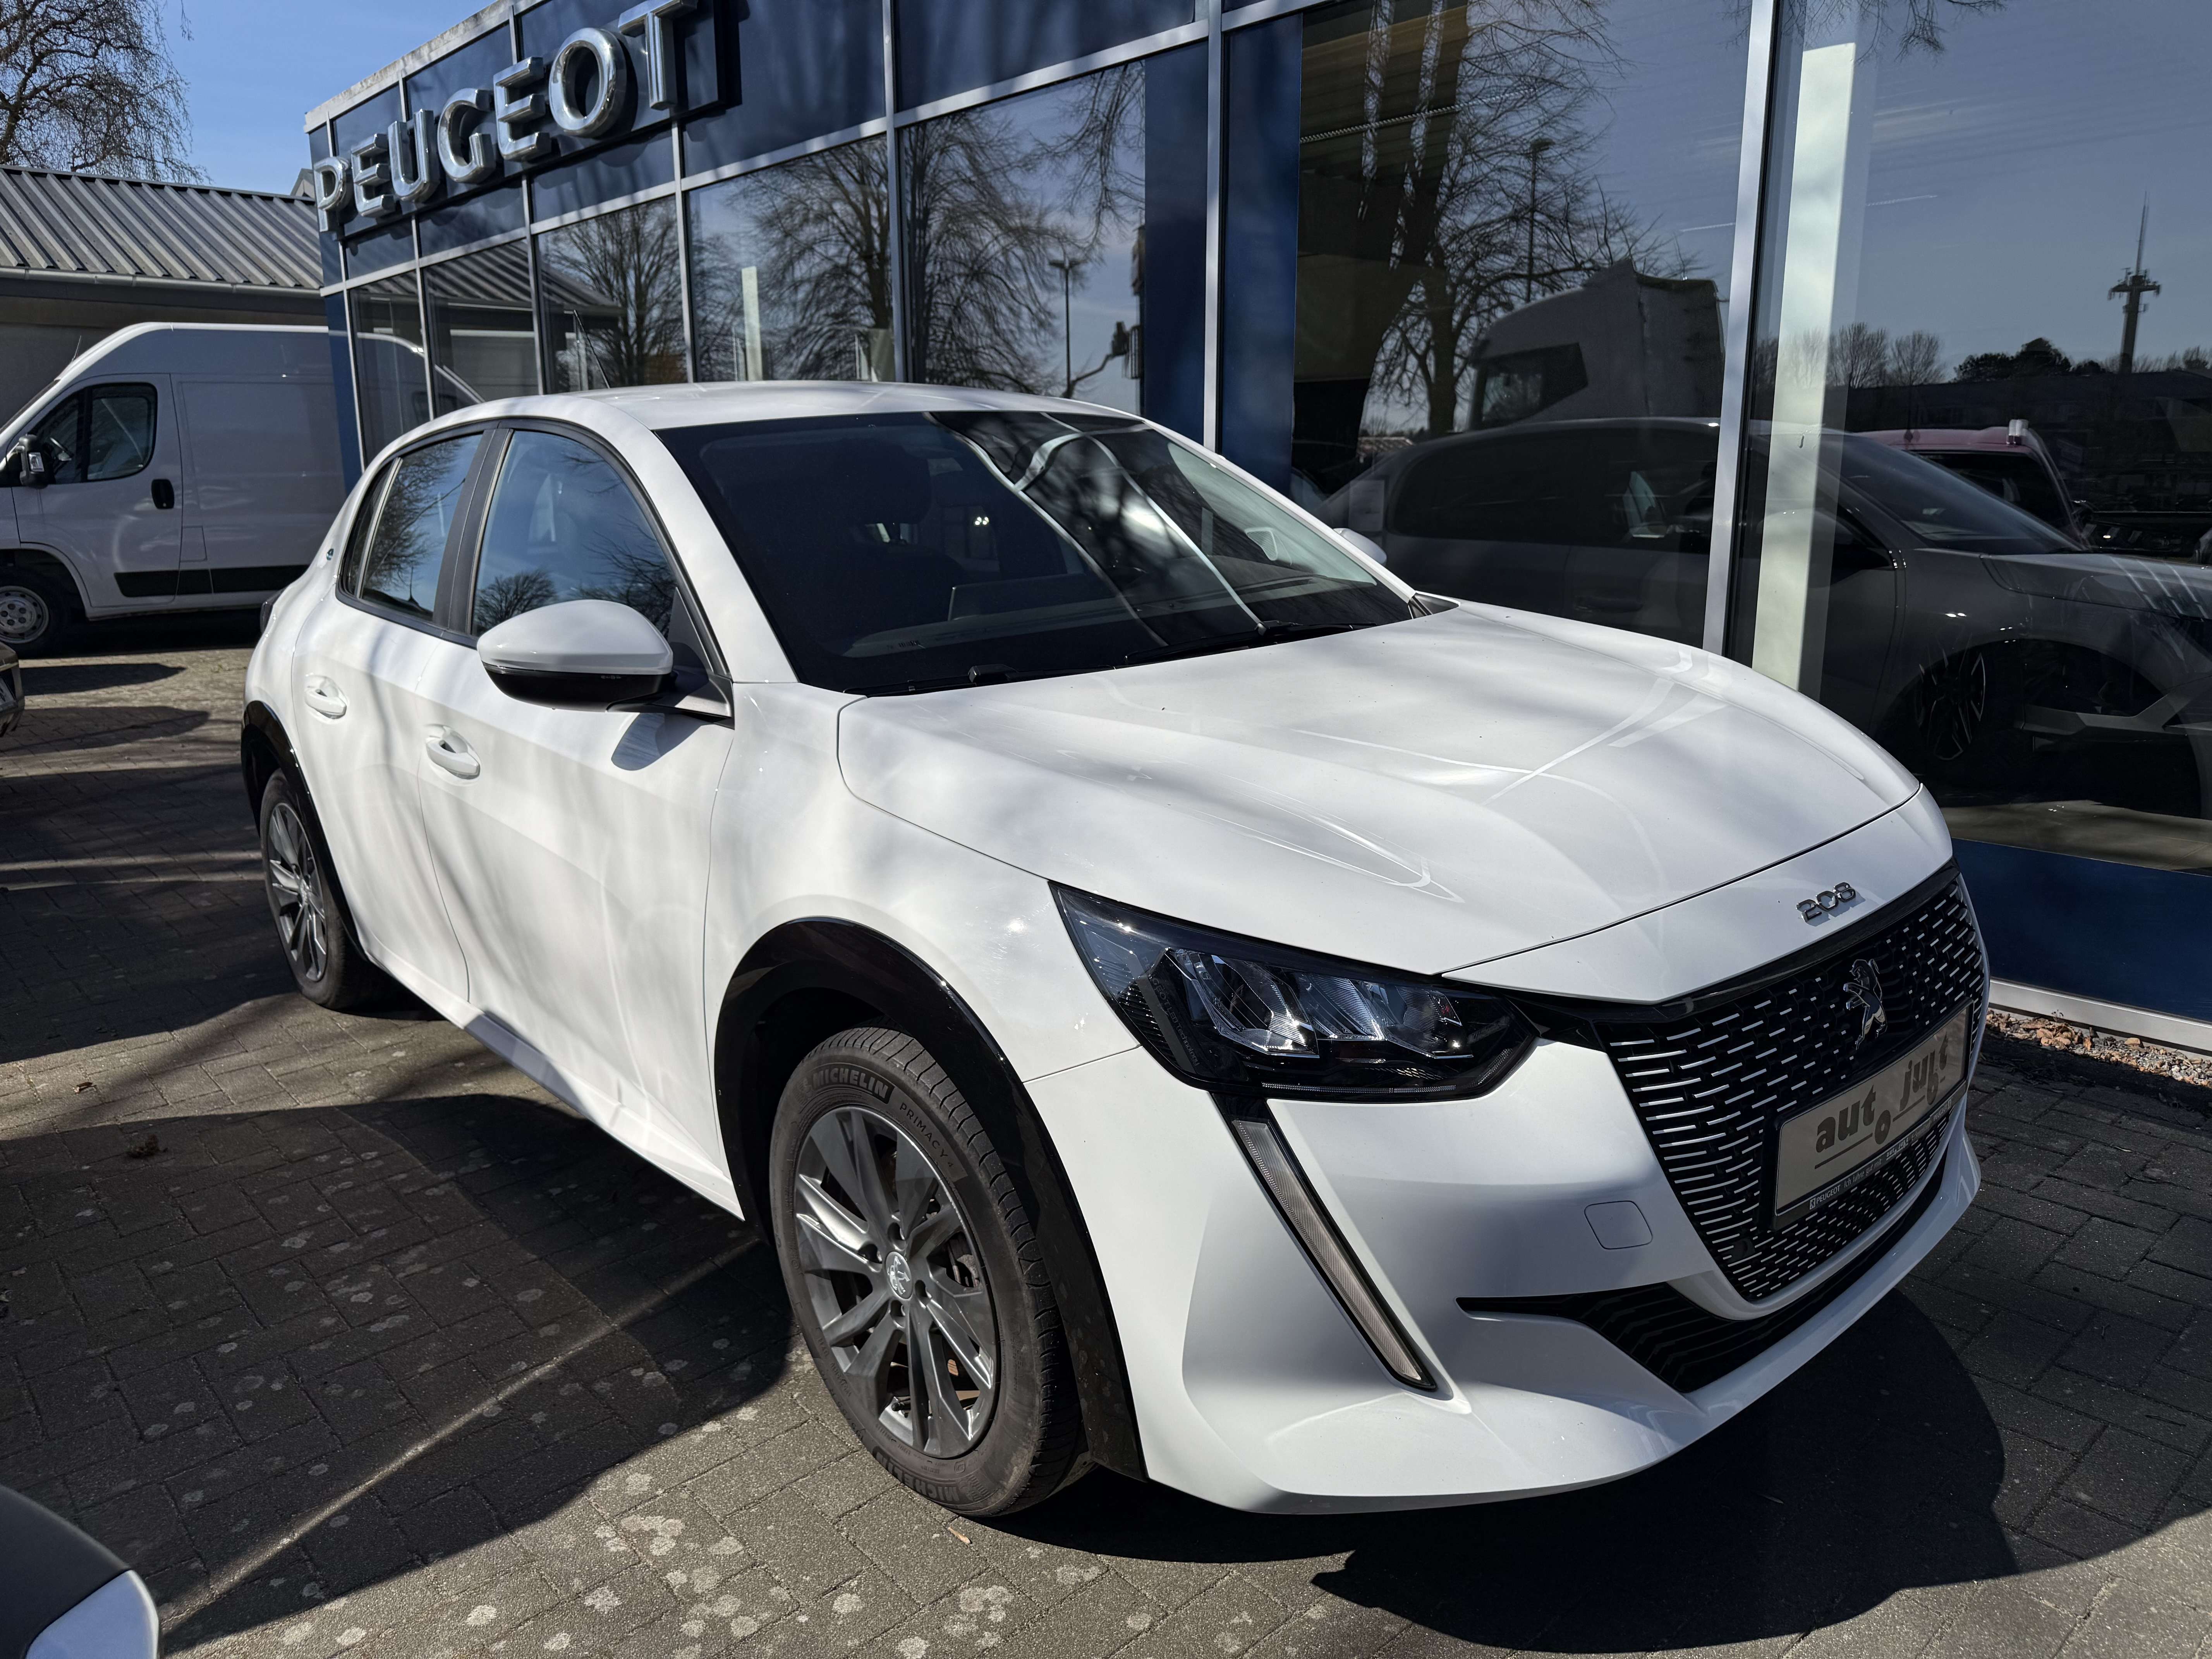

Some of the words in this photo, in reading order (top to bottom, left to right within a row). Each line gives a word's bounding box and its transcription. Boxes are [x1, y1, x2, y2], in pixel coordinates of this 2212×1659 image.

[314, 0, 697, 231] PEUGEOT
[1796, 882, 1856, 922] 208
[813, 1067, 889, 1099] MICHELIN
[899, 1103, 948, 1158] PRIMACY
[1816, 1184, 1841, 1204] PEUGEOT
[875, 1452, 960, 1501] MICHELIN
